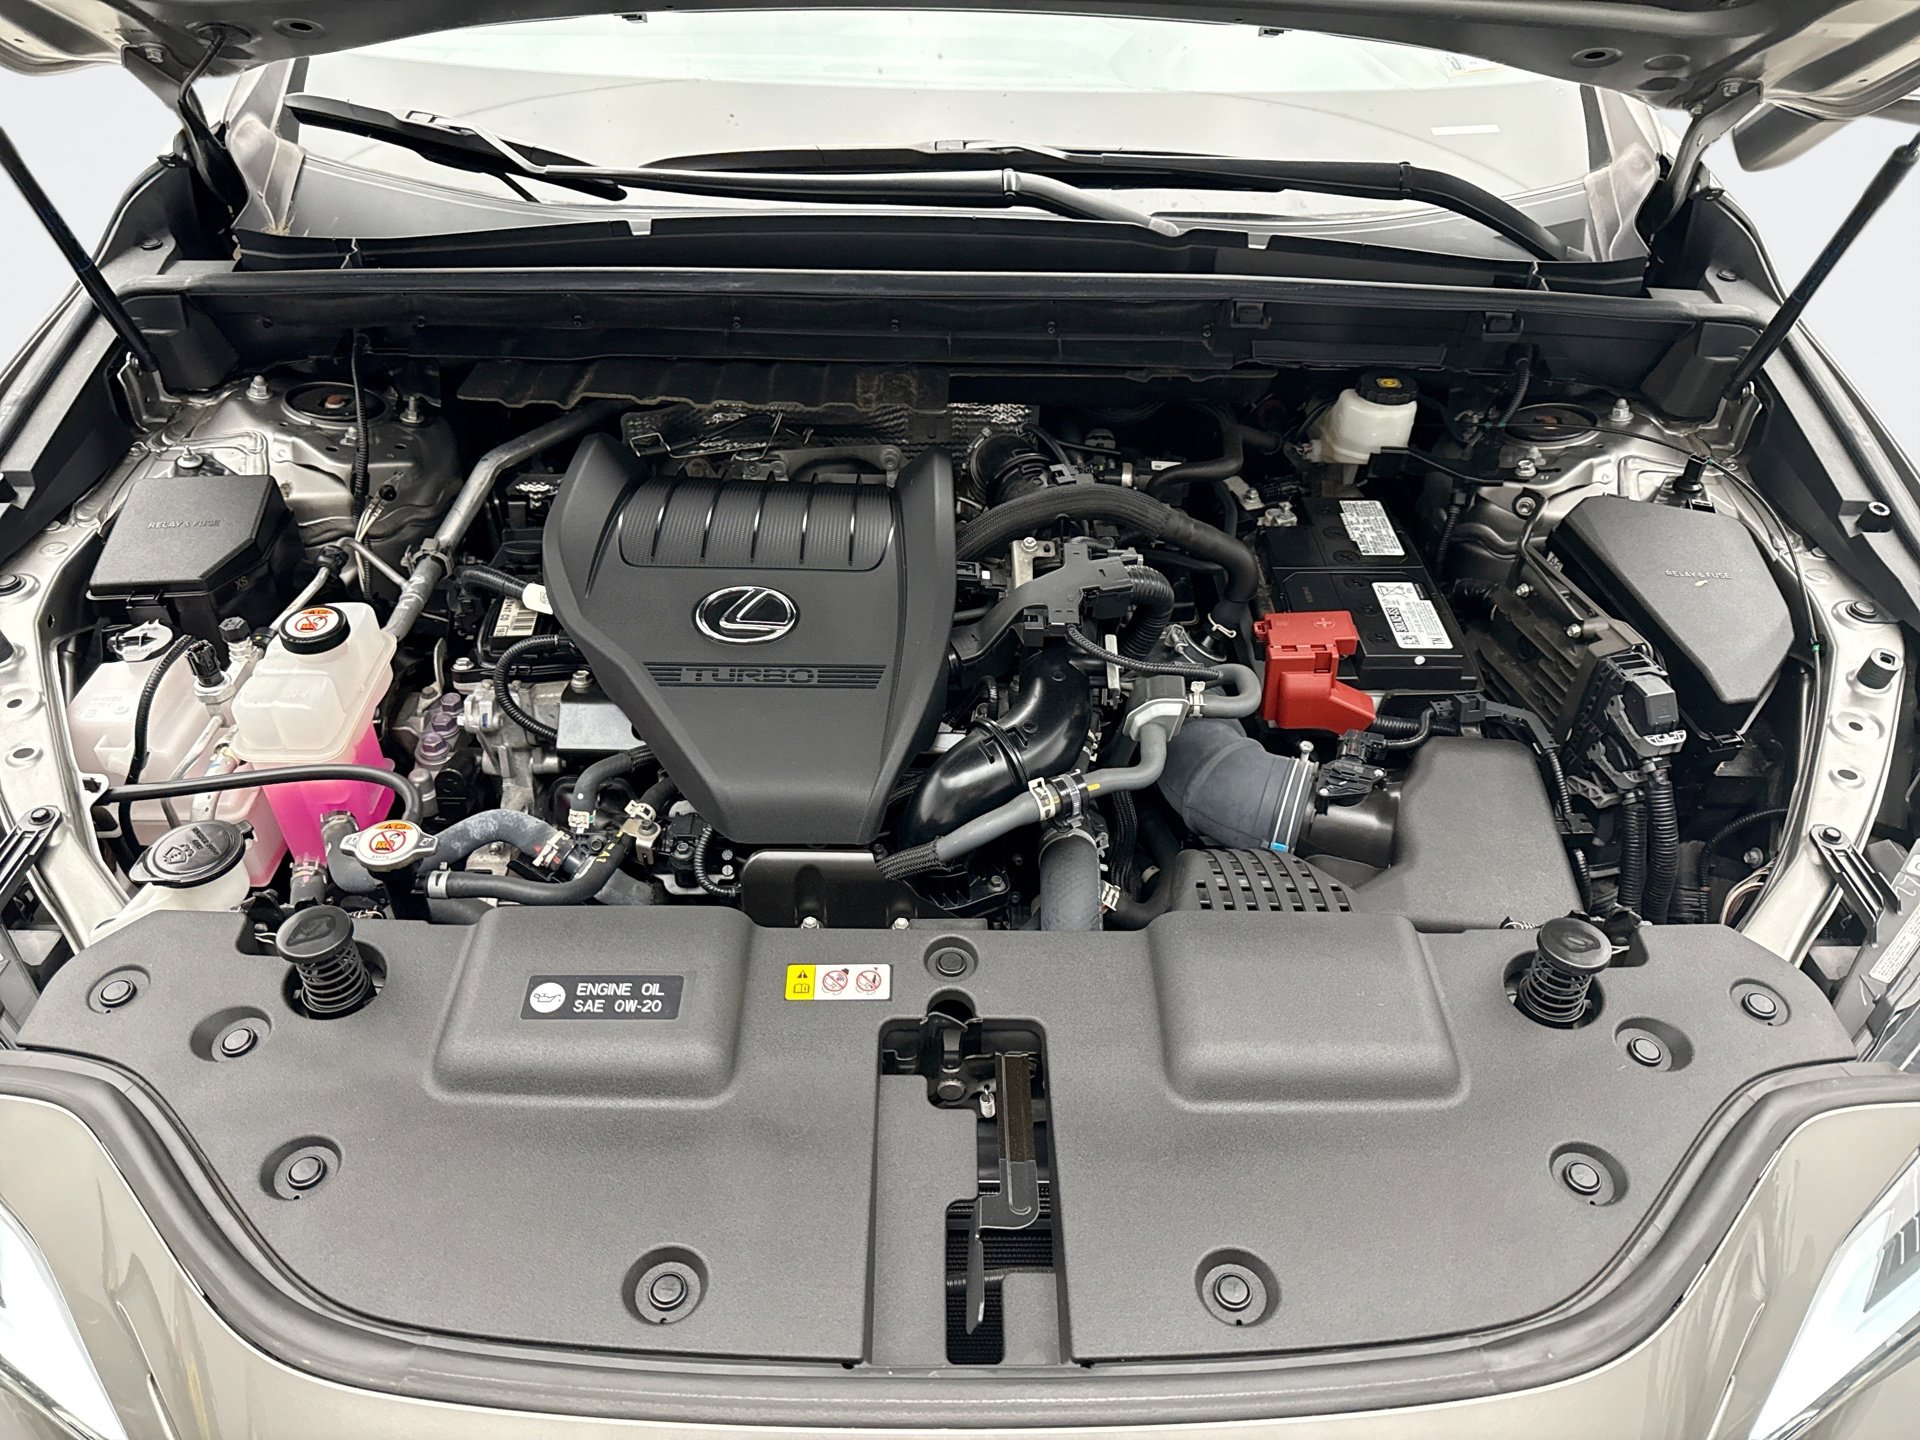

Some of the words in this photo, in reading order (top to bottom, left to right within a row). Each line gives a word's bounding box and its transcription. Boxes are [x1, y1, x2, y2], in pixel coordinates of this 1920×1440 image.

[148, 520, 183, 529] RELAY
[1665, 569, 1696, 578] RELAY
[686, 667, 815, 684] TURBO
[576, 983, 633, 996] ENGINE
[641, 983, 665, 996] OIL
[573, 1000, 605, 1013] SAE
[614, 1000, 662, 1013] 0W-20
